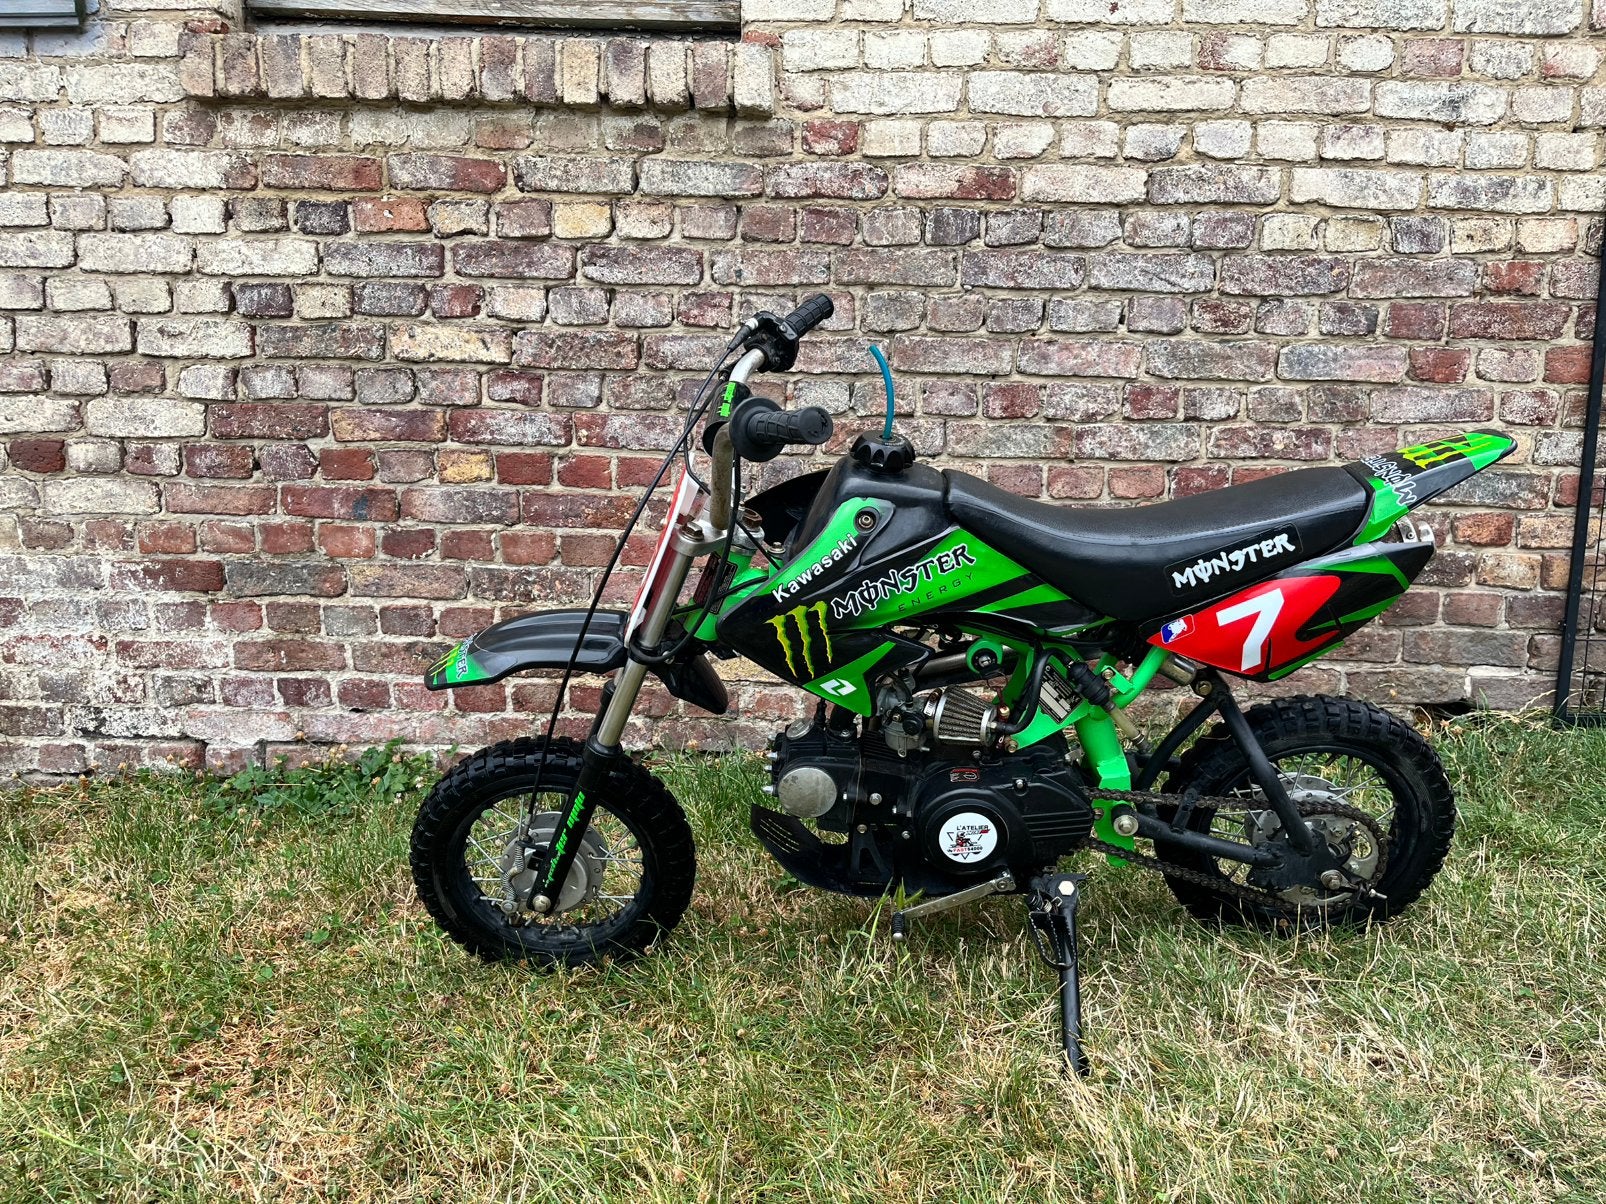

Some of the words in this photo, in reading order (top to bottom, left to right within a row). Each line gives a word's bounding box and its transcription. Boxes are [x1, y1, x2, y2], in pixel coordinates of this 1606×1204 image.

[1362, 455, 1417, 506] MONSTE
[772, 533, 858, 603] Kawasaki
[830, 543, 976, 619] MONSTER
[898, 571, 975, 612] ENERGY
[1171, 533, 1296, 589] MONSTER
[1216, 588, 1285, 671] 7
